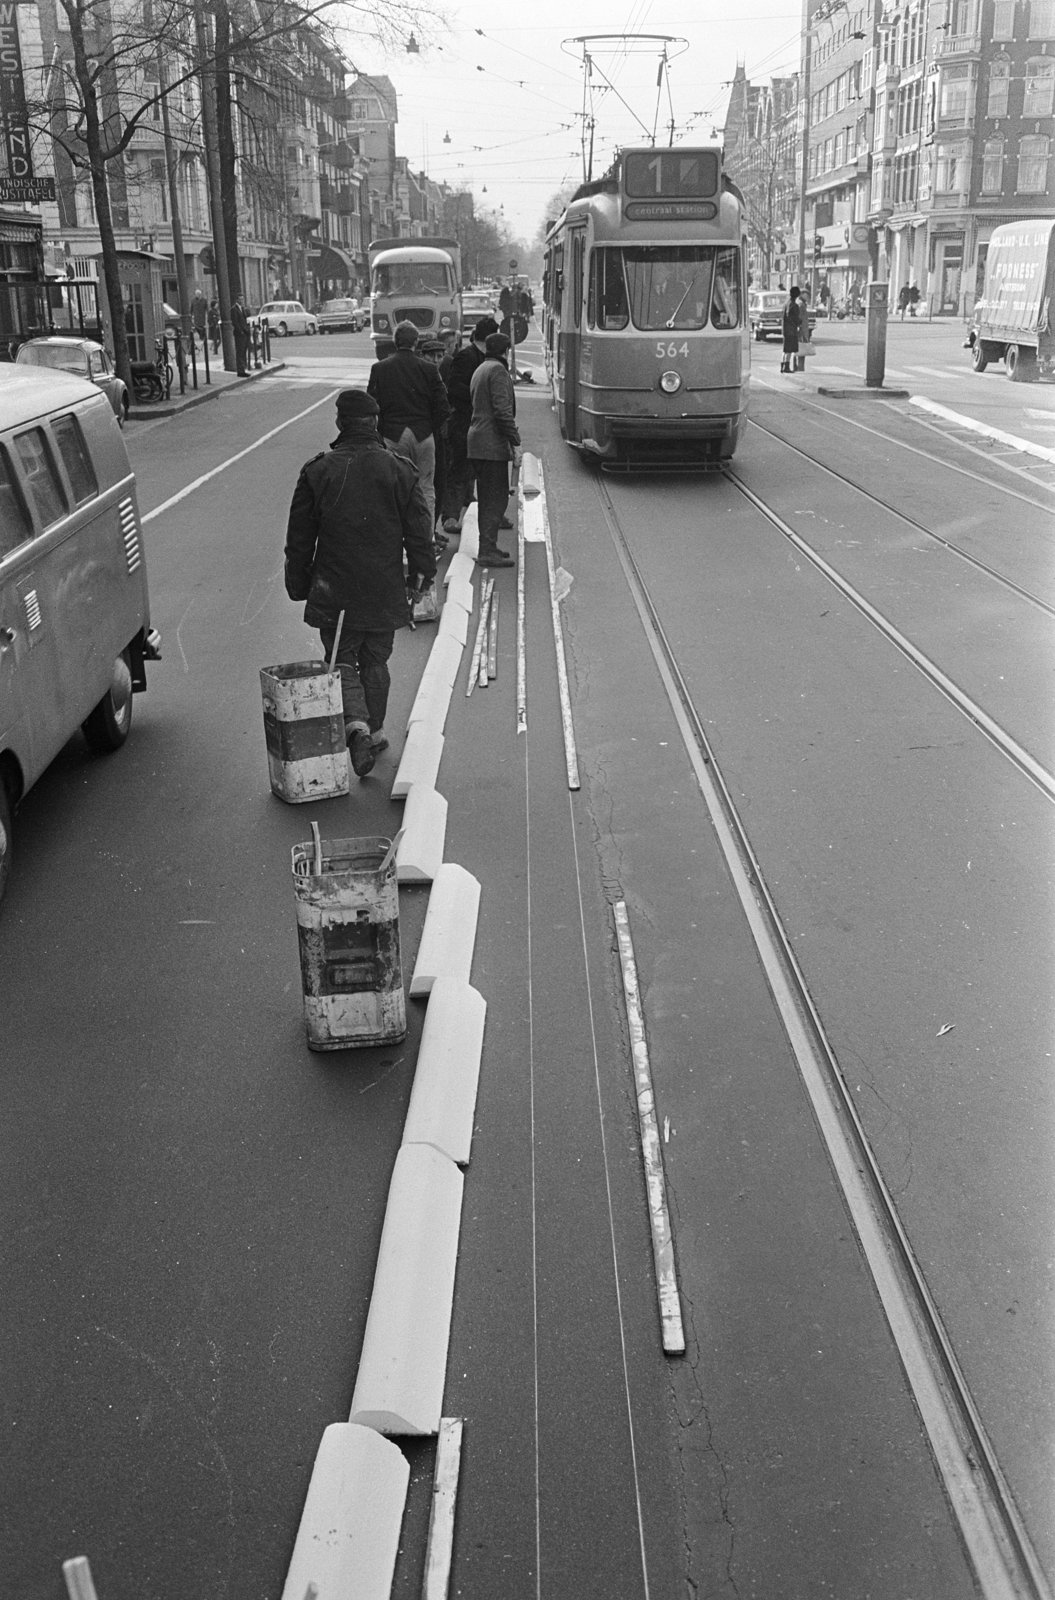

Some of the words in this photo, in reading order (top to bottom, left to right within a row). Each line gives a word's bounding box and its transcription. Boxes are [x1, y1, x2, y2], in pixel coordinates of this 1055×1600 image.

[648, 156, 663, 193] 1
[3, 178, 49, 188] INDISCHE
[676, 205, 709, 214] station
[655, 341, 690, 358] 564
